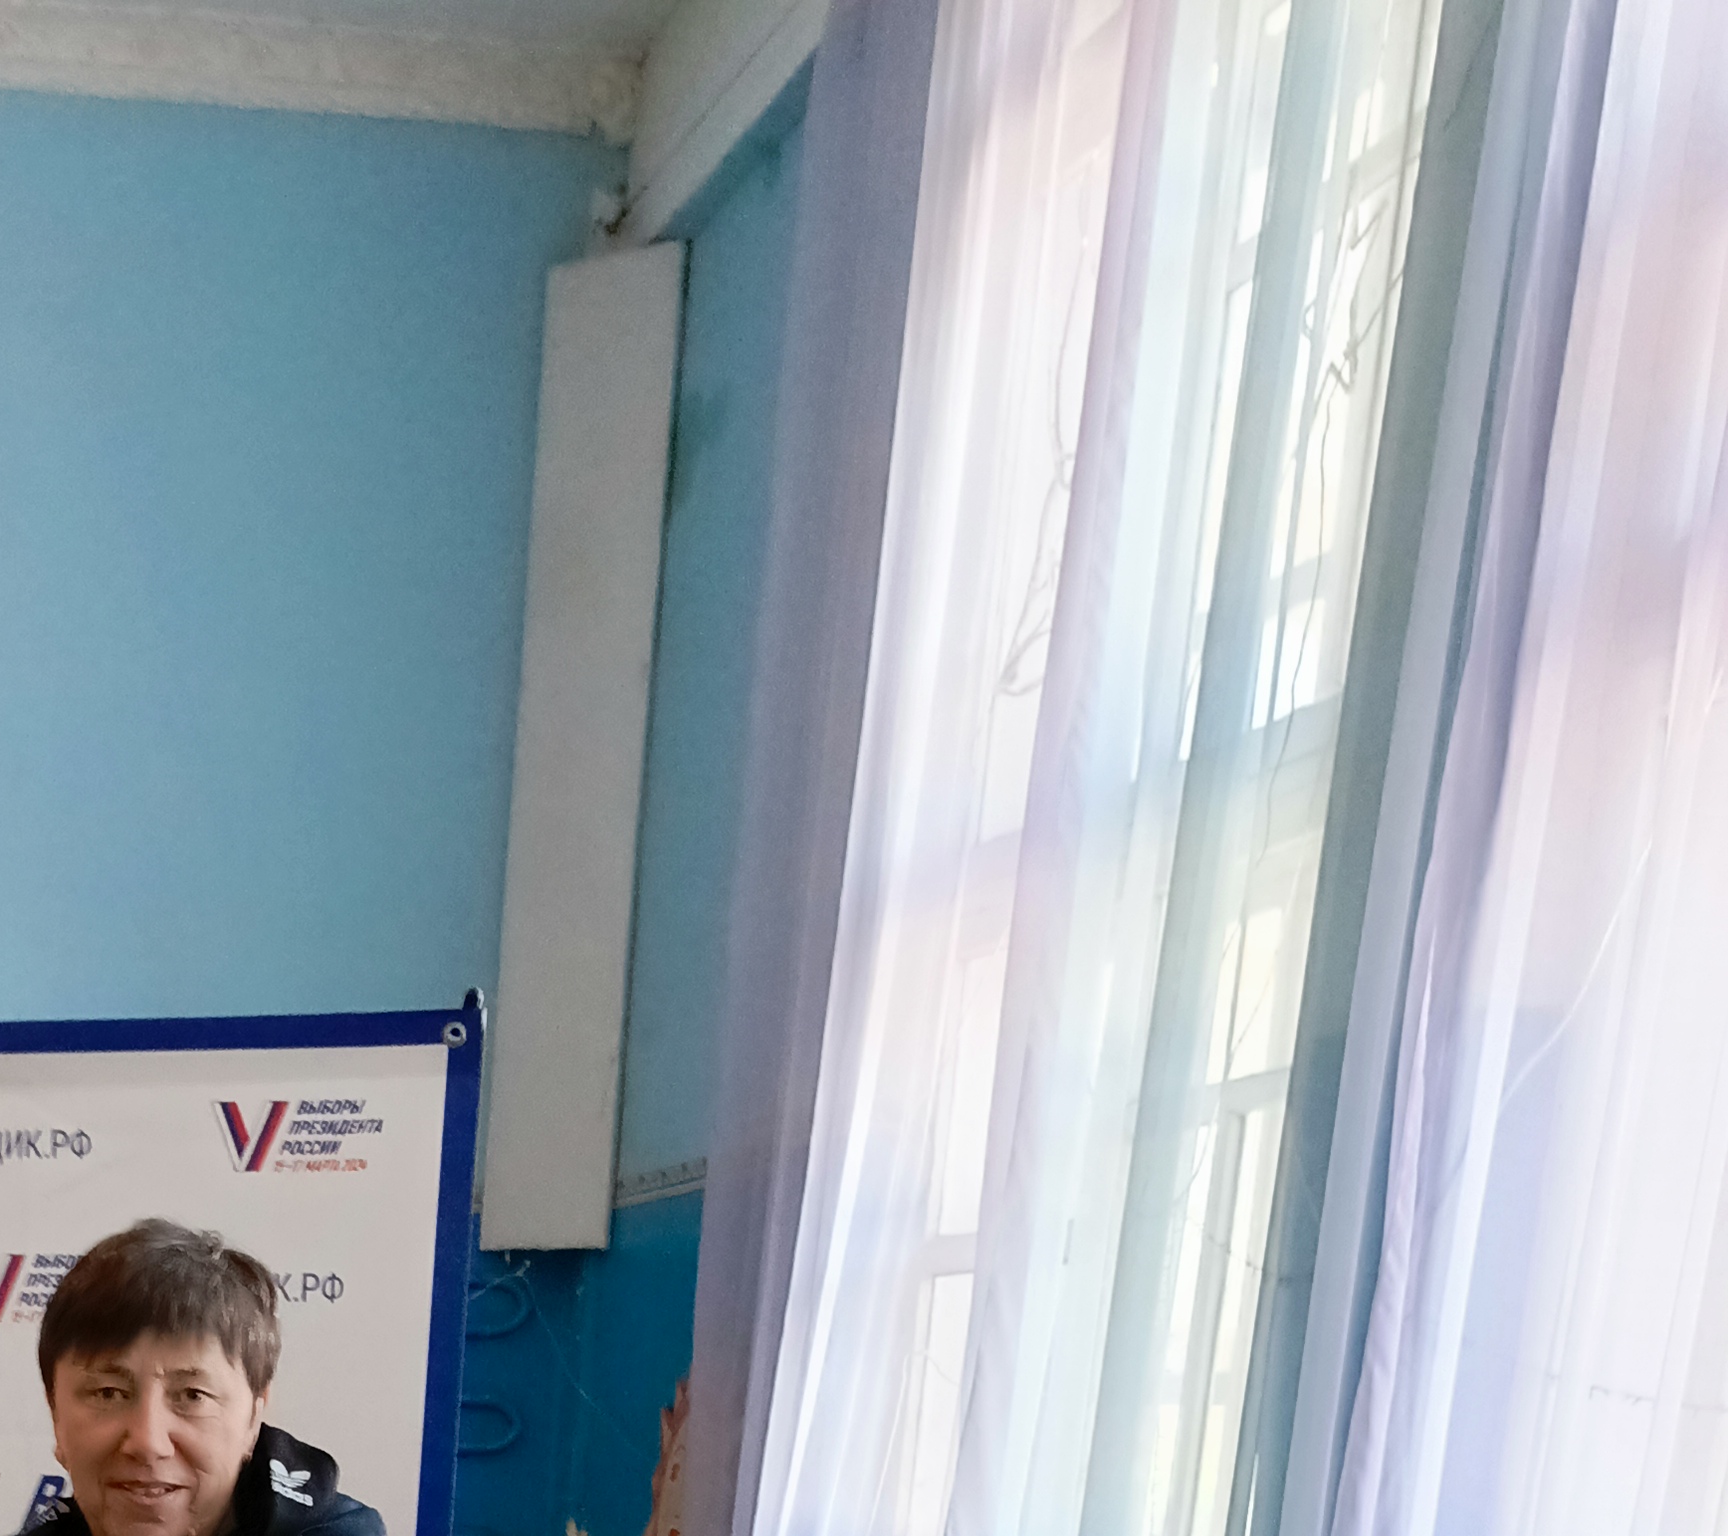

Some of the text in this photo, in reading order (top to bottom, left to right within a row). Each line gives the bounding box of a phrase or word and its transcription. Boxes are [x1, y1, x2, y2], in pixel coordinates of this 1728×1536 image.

[297, 1099, 366, 1116] ВЫБОРЫ
[288, 1119, 384, 1136] ПРЕЗИДЕНТА
[279, 1140, 342, 1155] РОССИИ
